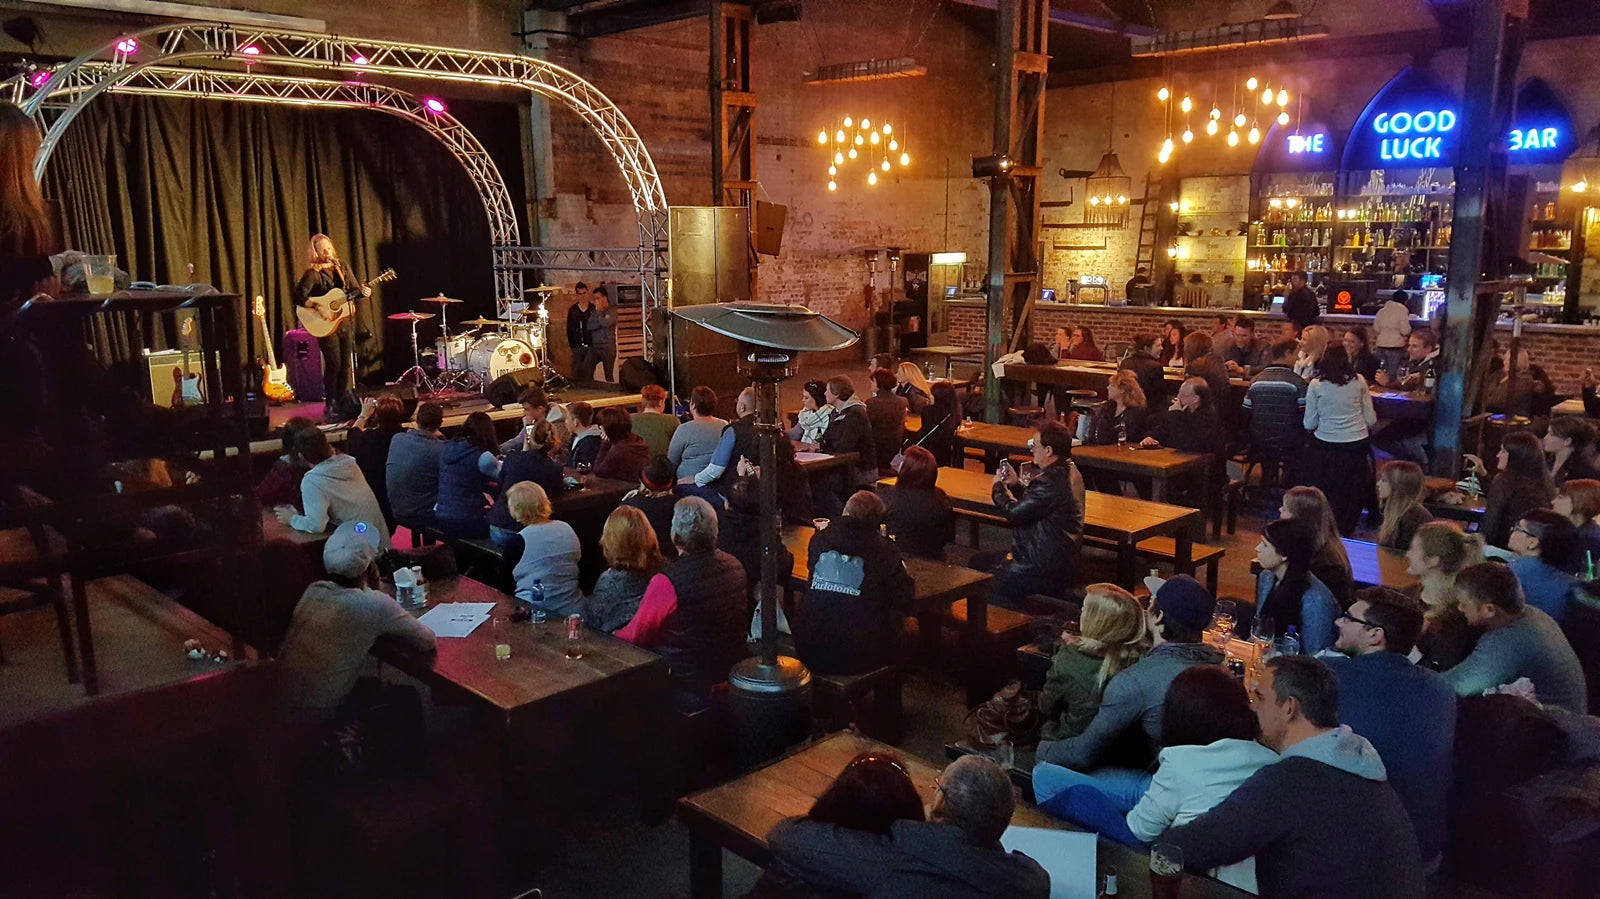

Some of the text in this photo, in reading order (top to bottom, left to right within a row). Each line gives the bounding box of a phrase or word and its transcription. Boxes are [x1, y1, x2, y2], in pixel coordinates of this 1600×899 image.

[1373, 110, 1456, 134] GOOD
[1380, 136, 1442, 160] LUCK
[810, 581, 861, 596] Parlotones
